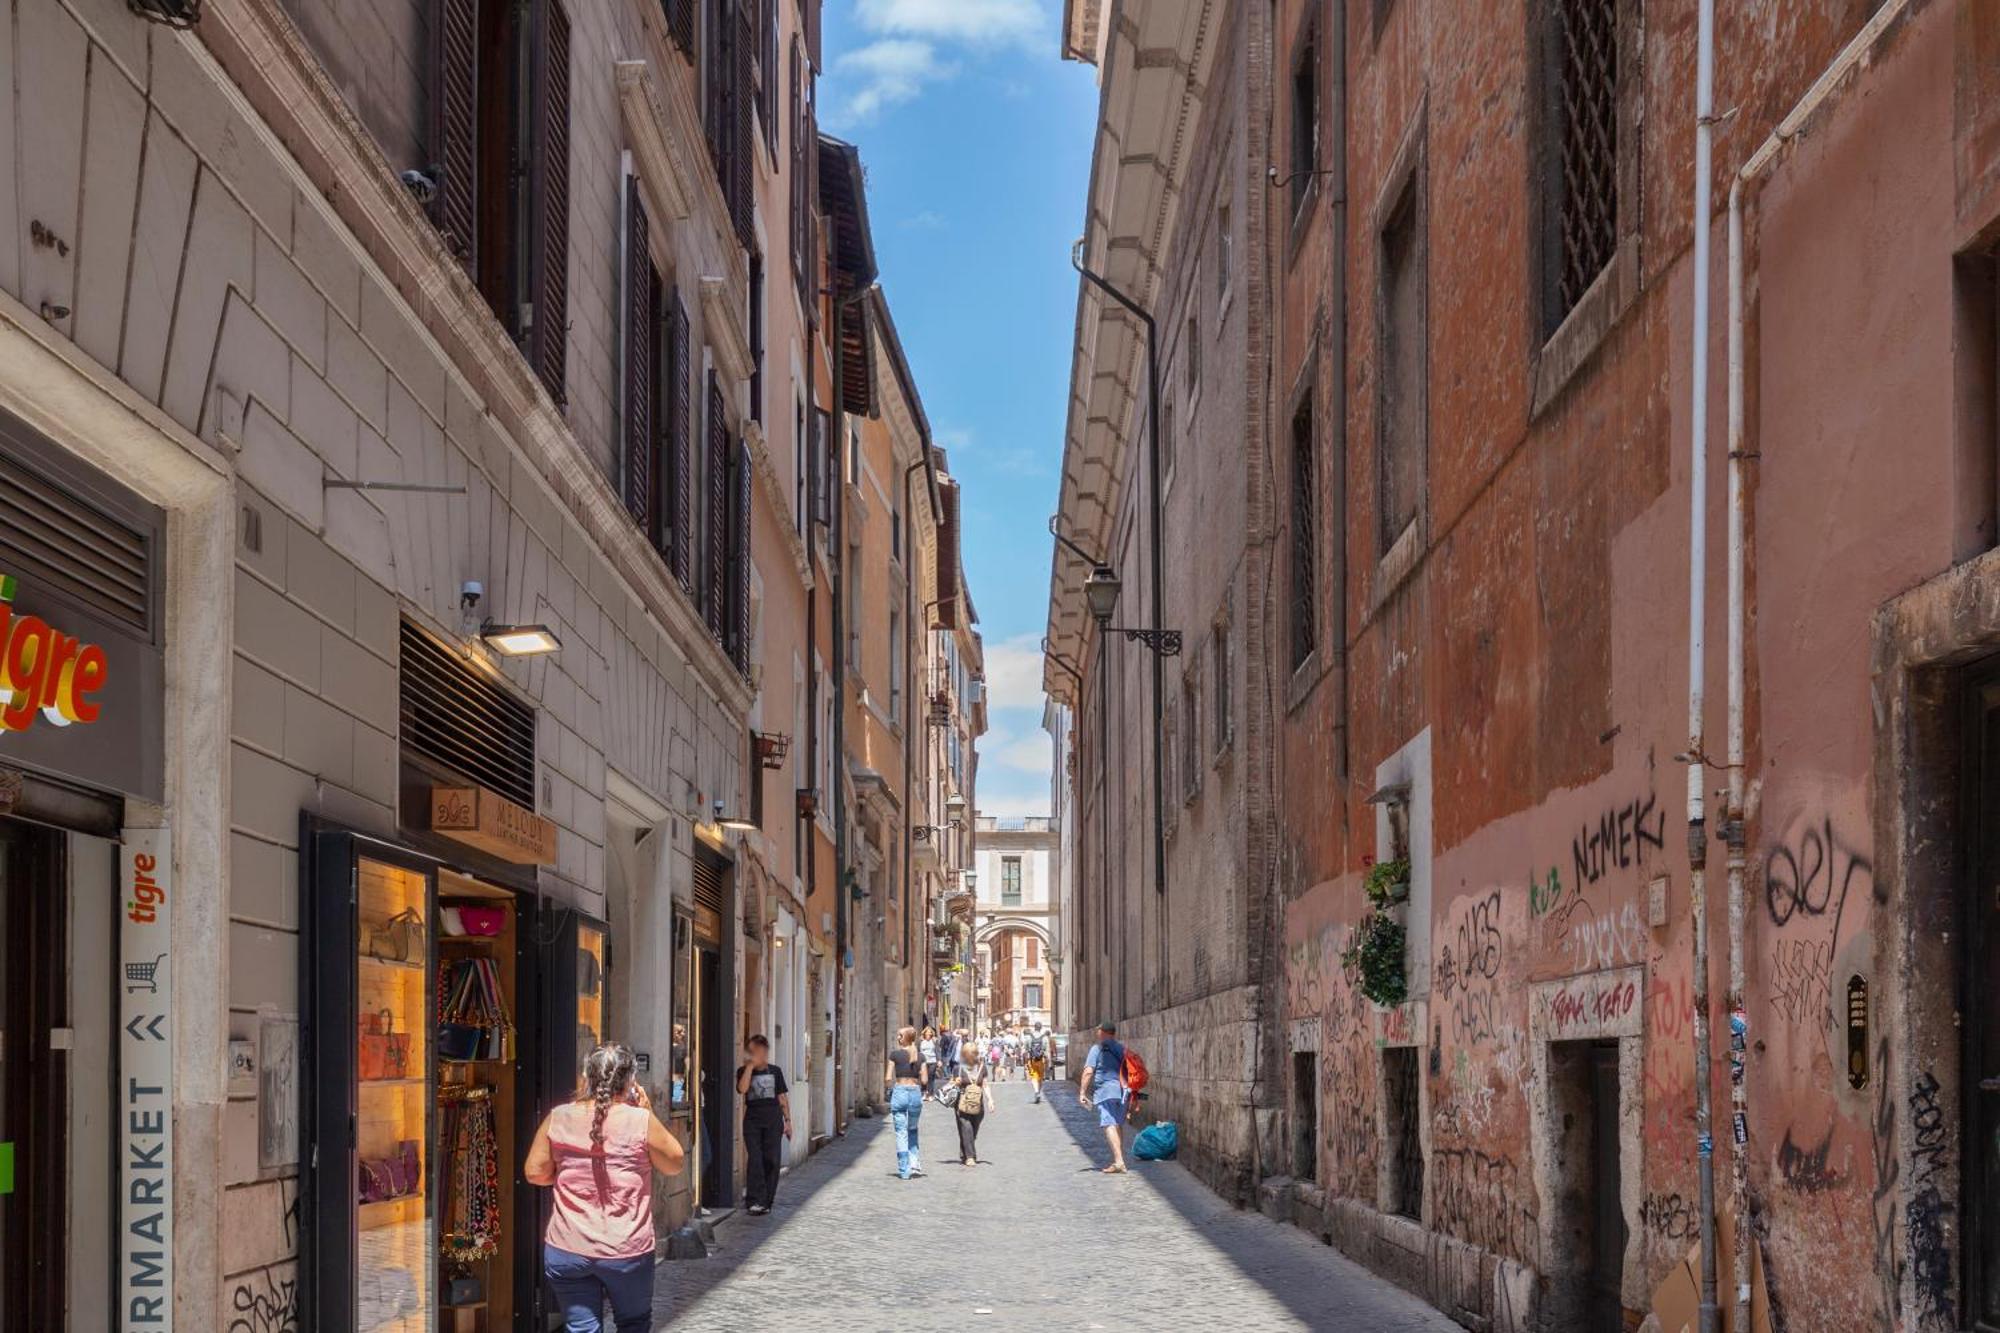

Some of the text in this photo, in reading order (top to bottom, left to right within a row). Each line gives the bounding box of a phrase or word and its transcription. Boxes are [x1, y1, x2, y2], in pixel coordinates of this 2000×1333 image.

[497, 801, 545, 841] MELODY
[128, 853, 165, 924] tigre
[129, 1077, 164, 1333] RMARKET
